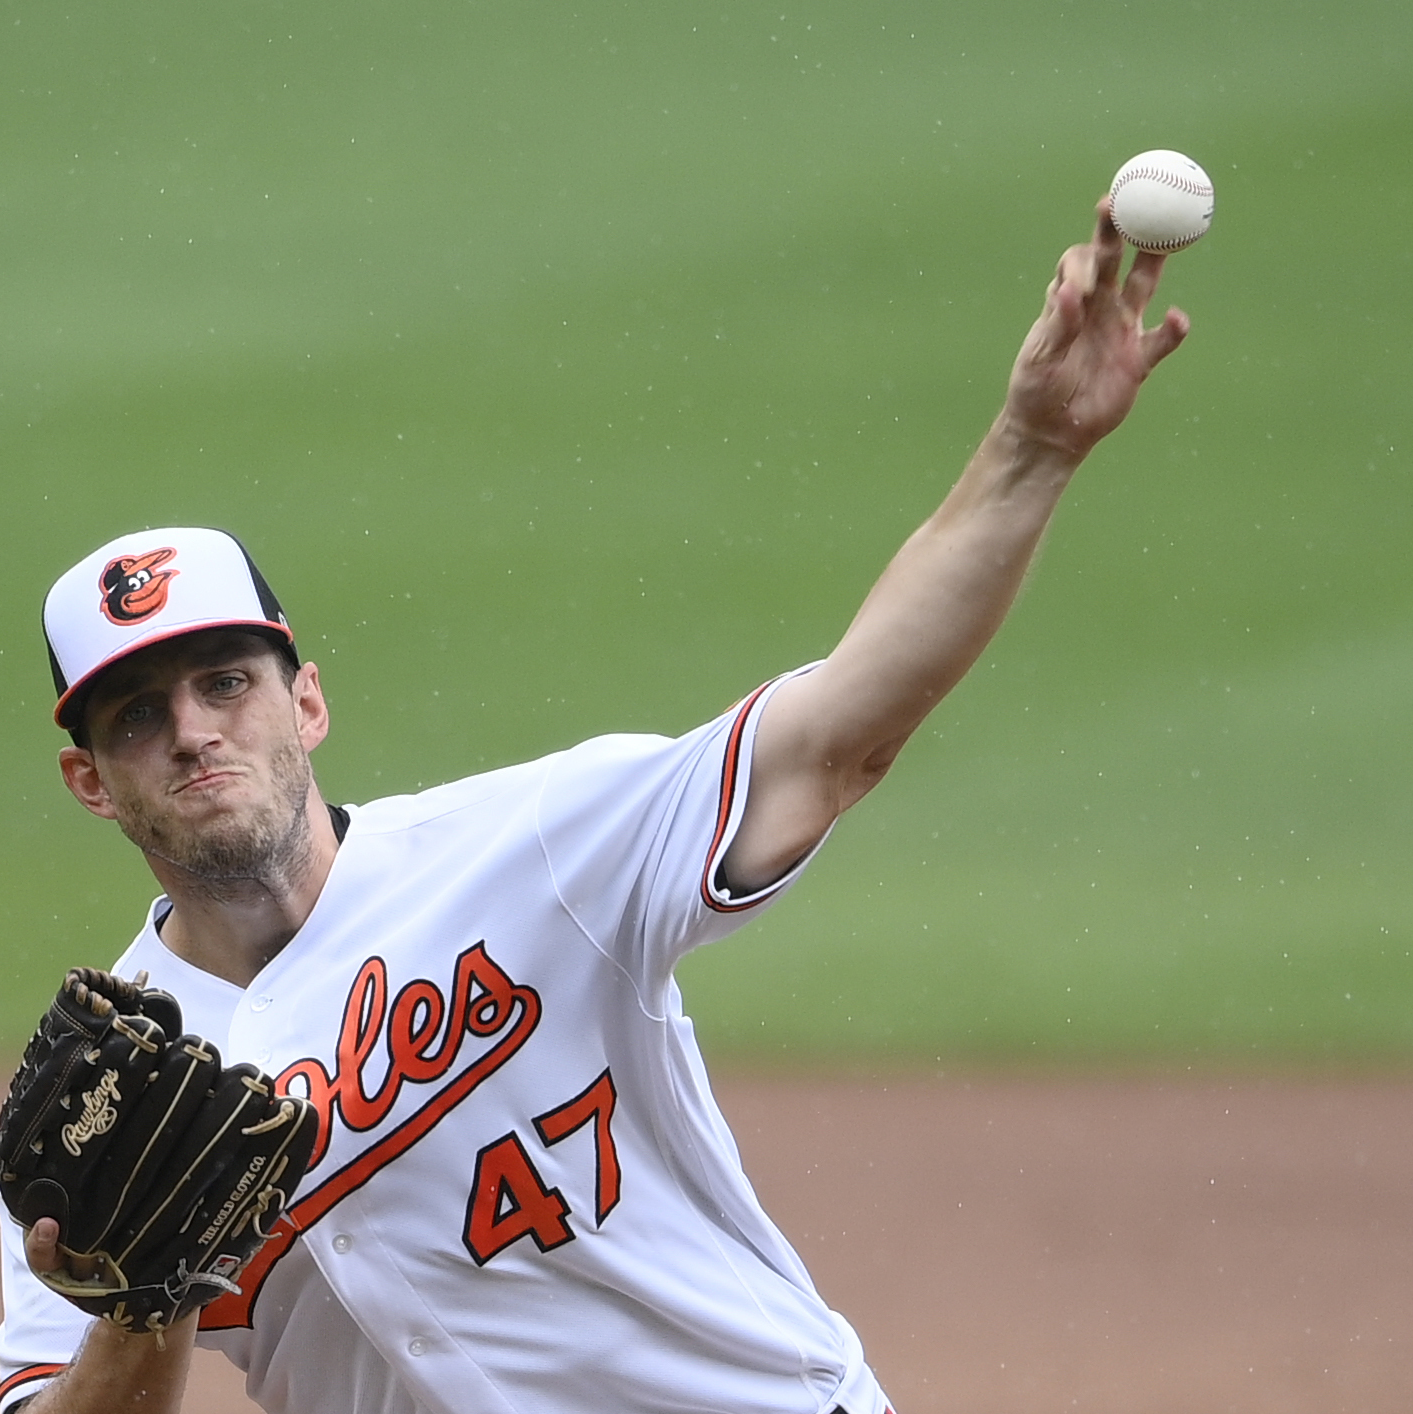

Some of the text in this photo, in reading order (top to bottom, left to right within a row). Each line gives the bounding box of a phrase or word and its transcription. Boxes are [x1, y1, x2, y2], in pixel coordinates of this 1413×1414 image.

[61, 1068, 122, 1157] Rawlings
[272, 939, 542, 1172] oles
[197, 1225, 220, 1245] THE
[212, 1200, 235, 1227] GOLD
[229, 1170, 257, 1202] GLOVE
[462, 1066, 622, 1267] 47
